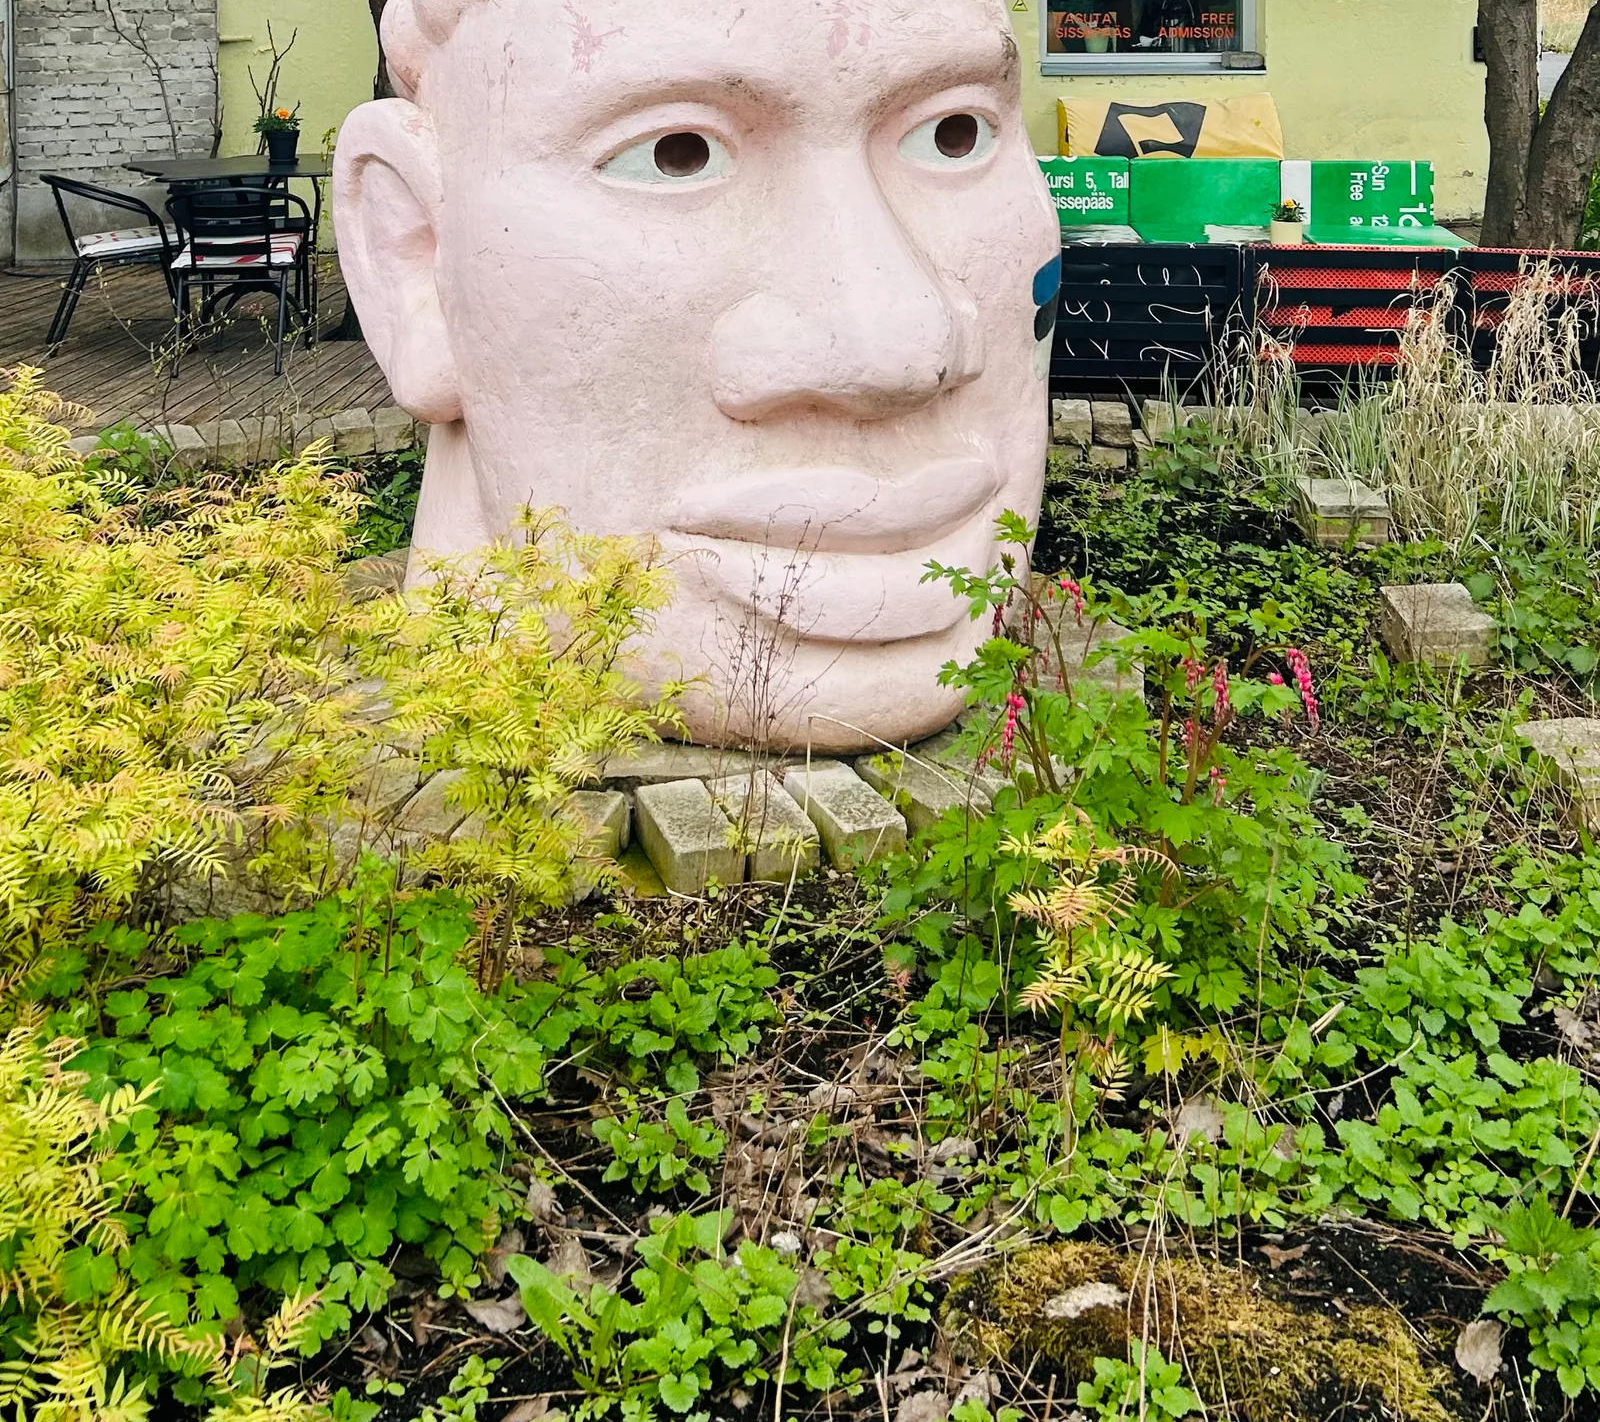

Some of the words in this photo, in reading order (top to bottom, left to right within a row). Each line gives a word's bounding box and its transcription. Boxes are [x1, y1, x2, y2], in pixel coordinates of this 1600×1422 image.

[1201, 13, 1234, 25] FREE
[1159, 27, 1234, 38] ADMISSION
[1085, 172, 1097, 192] 5,
[1349, 172, 1368, 201] Free
